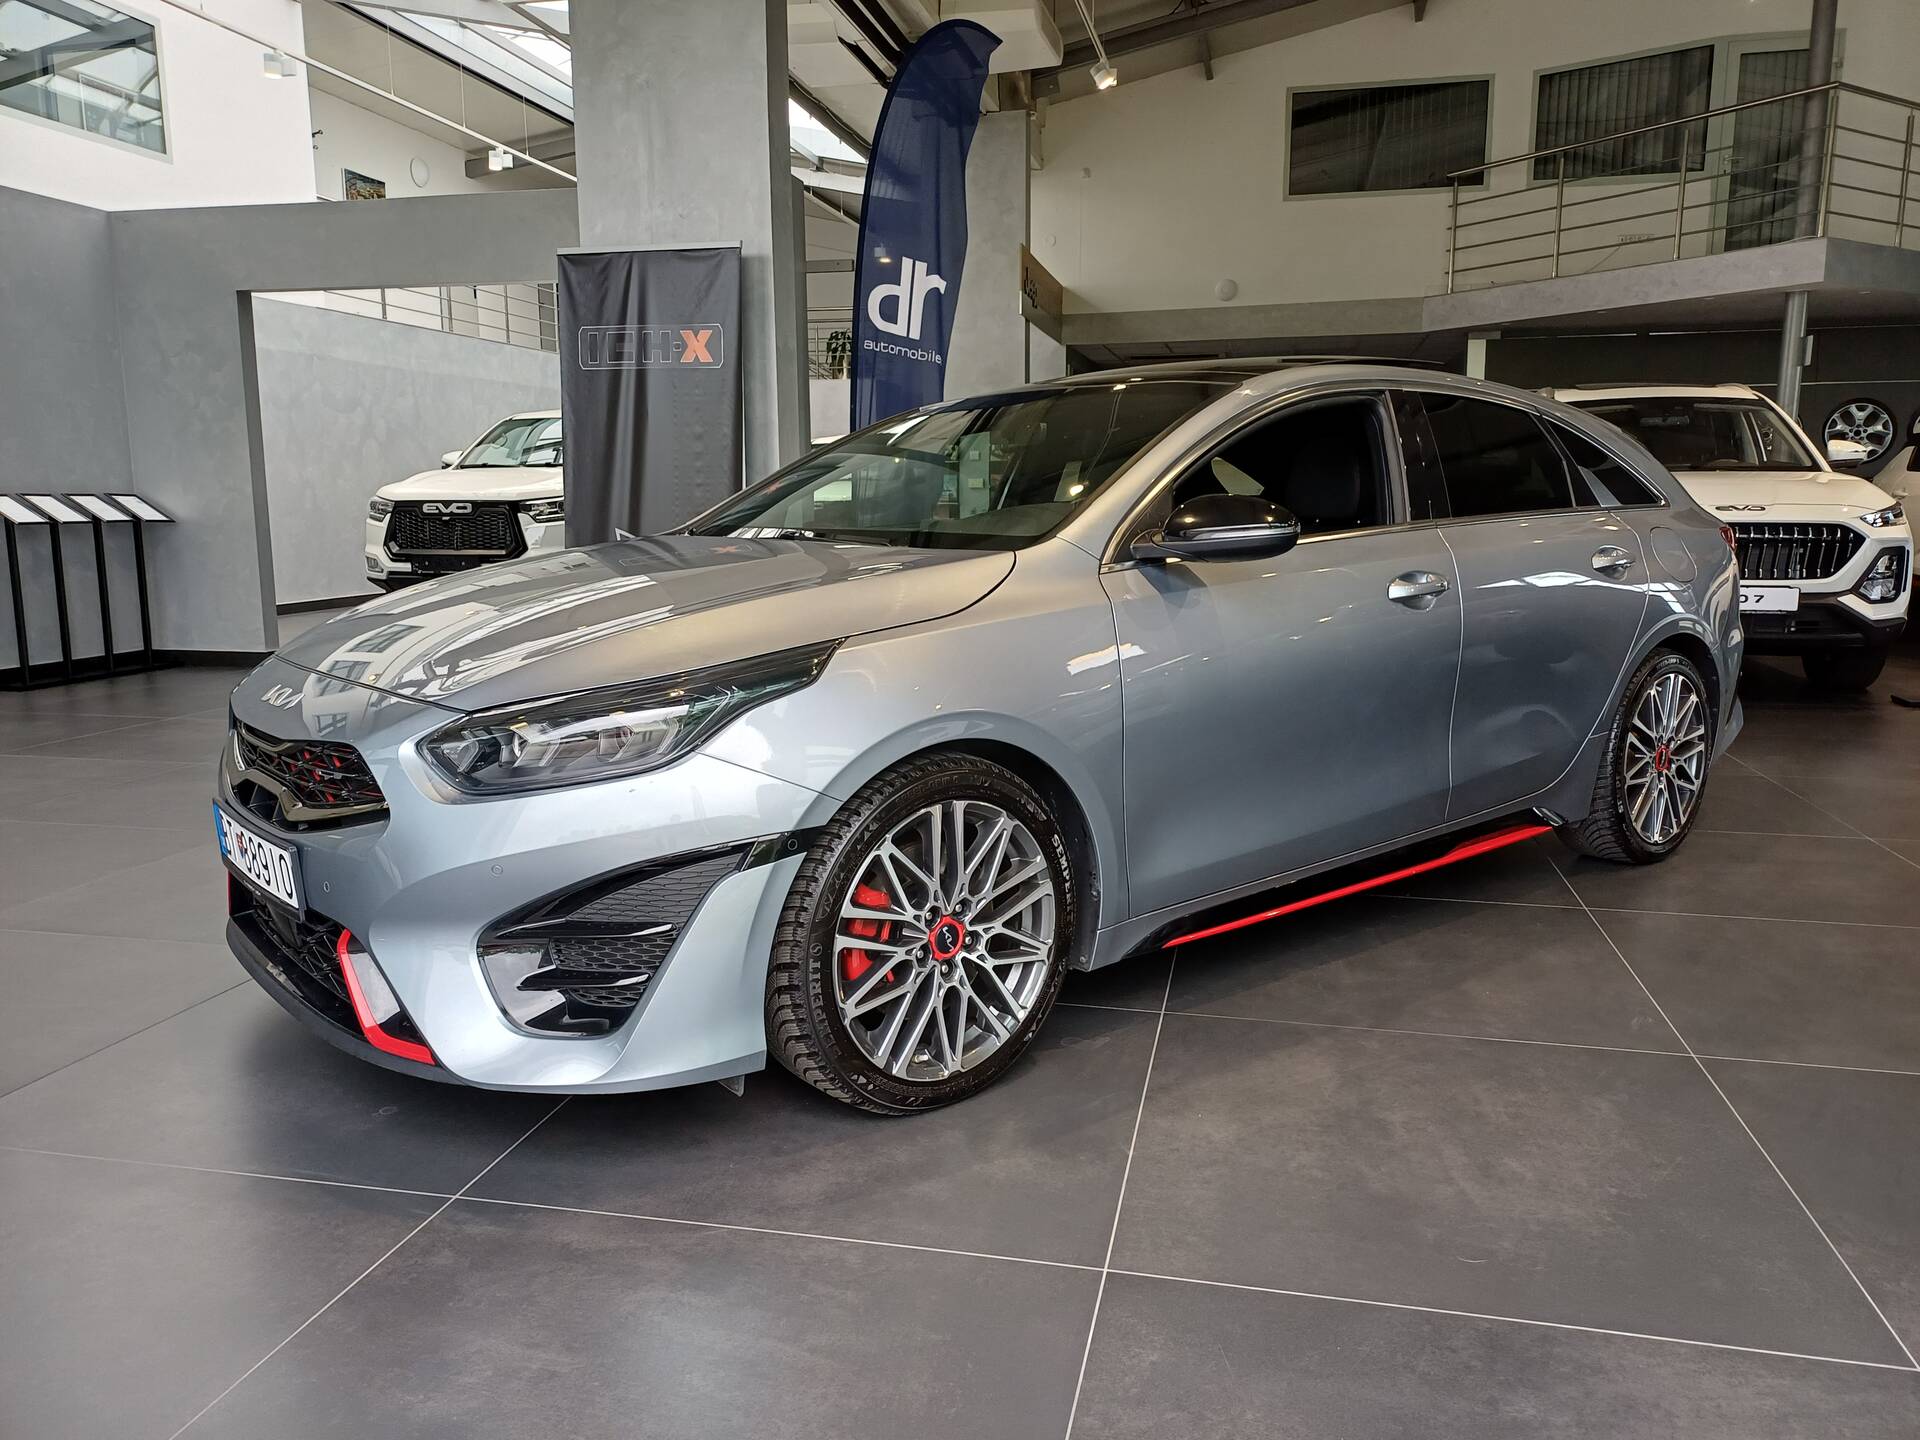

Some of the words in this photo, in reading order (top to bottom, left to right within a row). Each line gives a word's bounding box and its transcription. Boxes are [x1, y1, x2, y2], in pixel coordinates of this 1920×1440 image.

[867, 256, 947, 340] dr
[863, 339, 942, 364] automobile
[422, 502, 473, 514] EVO
